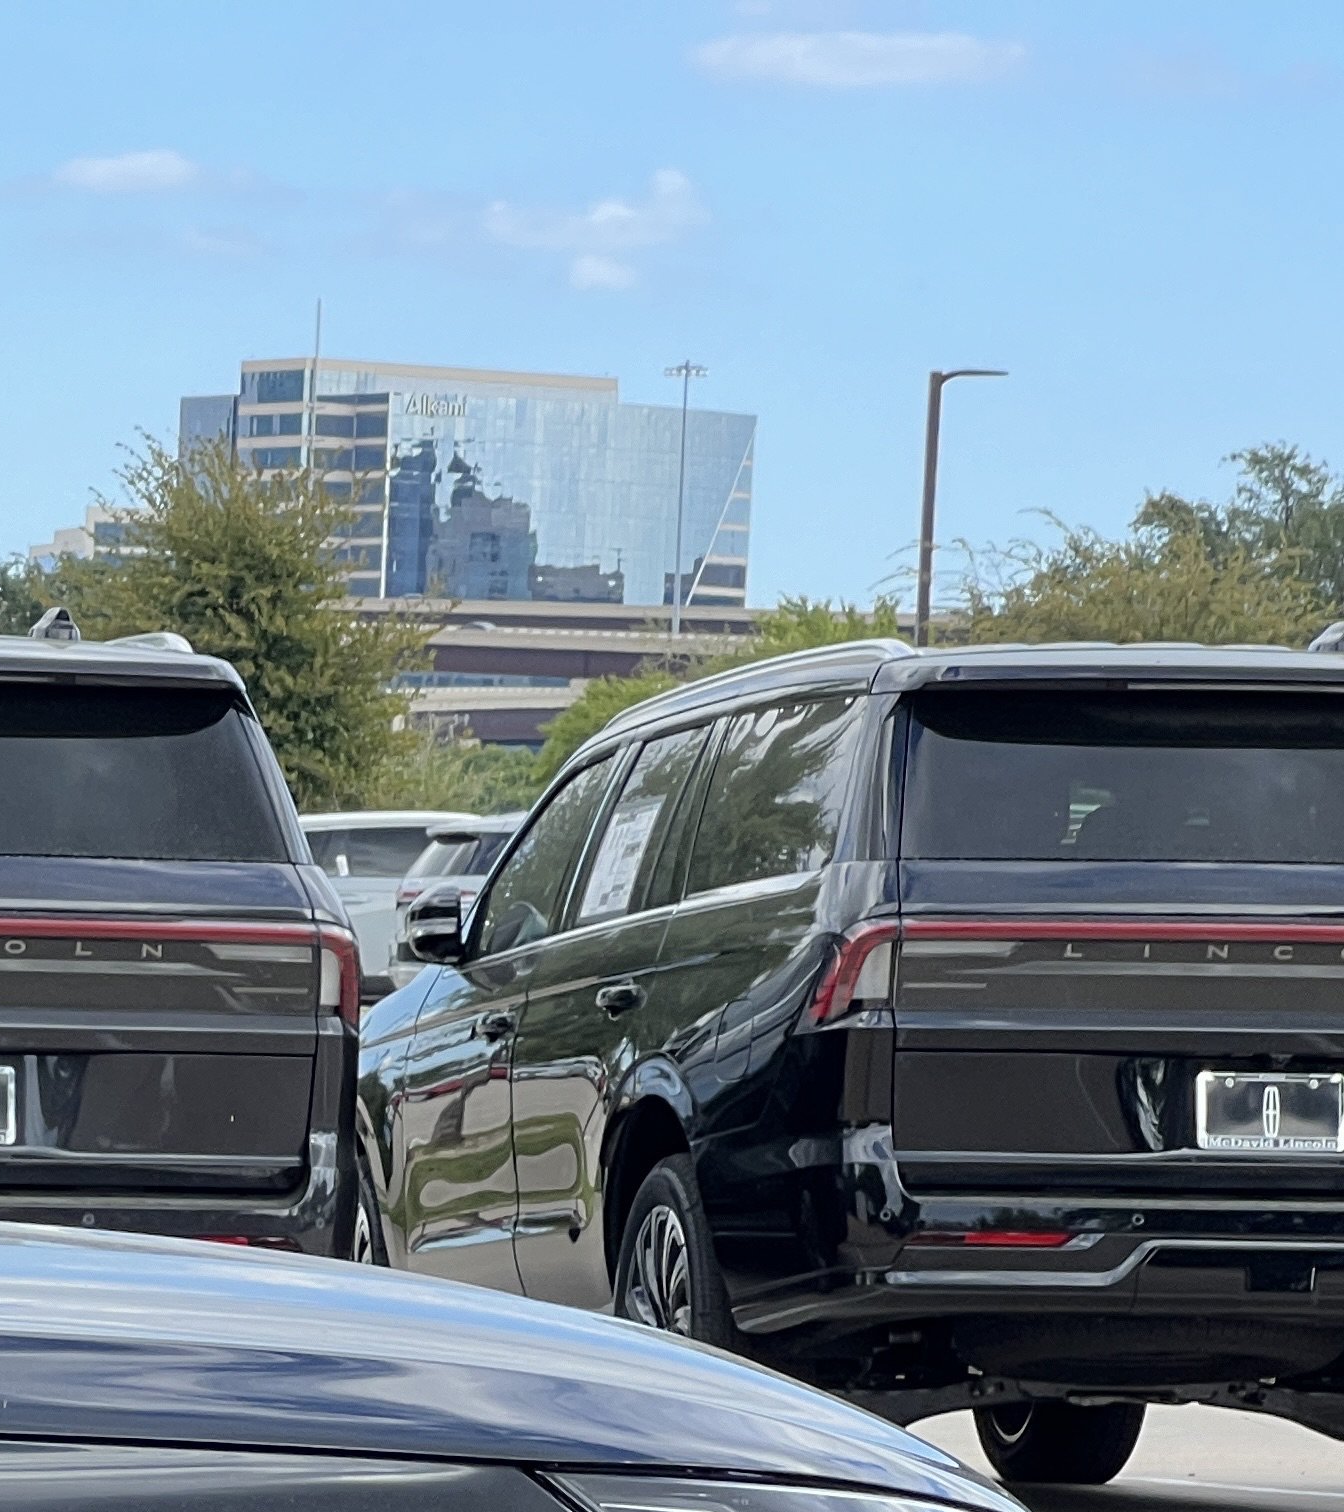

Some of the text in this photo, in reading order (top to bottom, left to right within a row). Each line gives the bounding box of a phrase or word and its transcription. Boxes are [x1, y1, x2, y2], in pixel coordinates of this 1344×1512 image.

[1064, 943, 1344, 960] LINC
[1208, 1136, 1337, 1150] McDavid Lincoln
